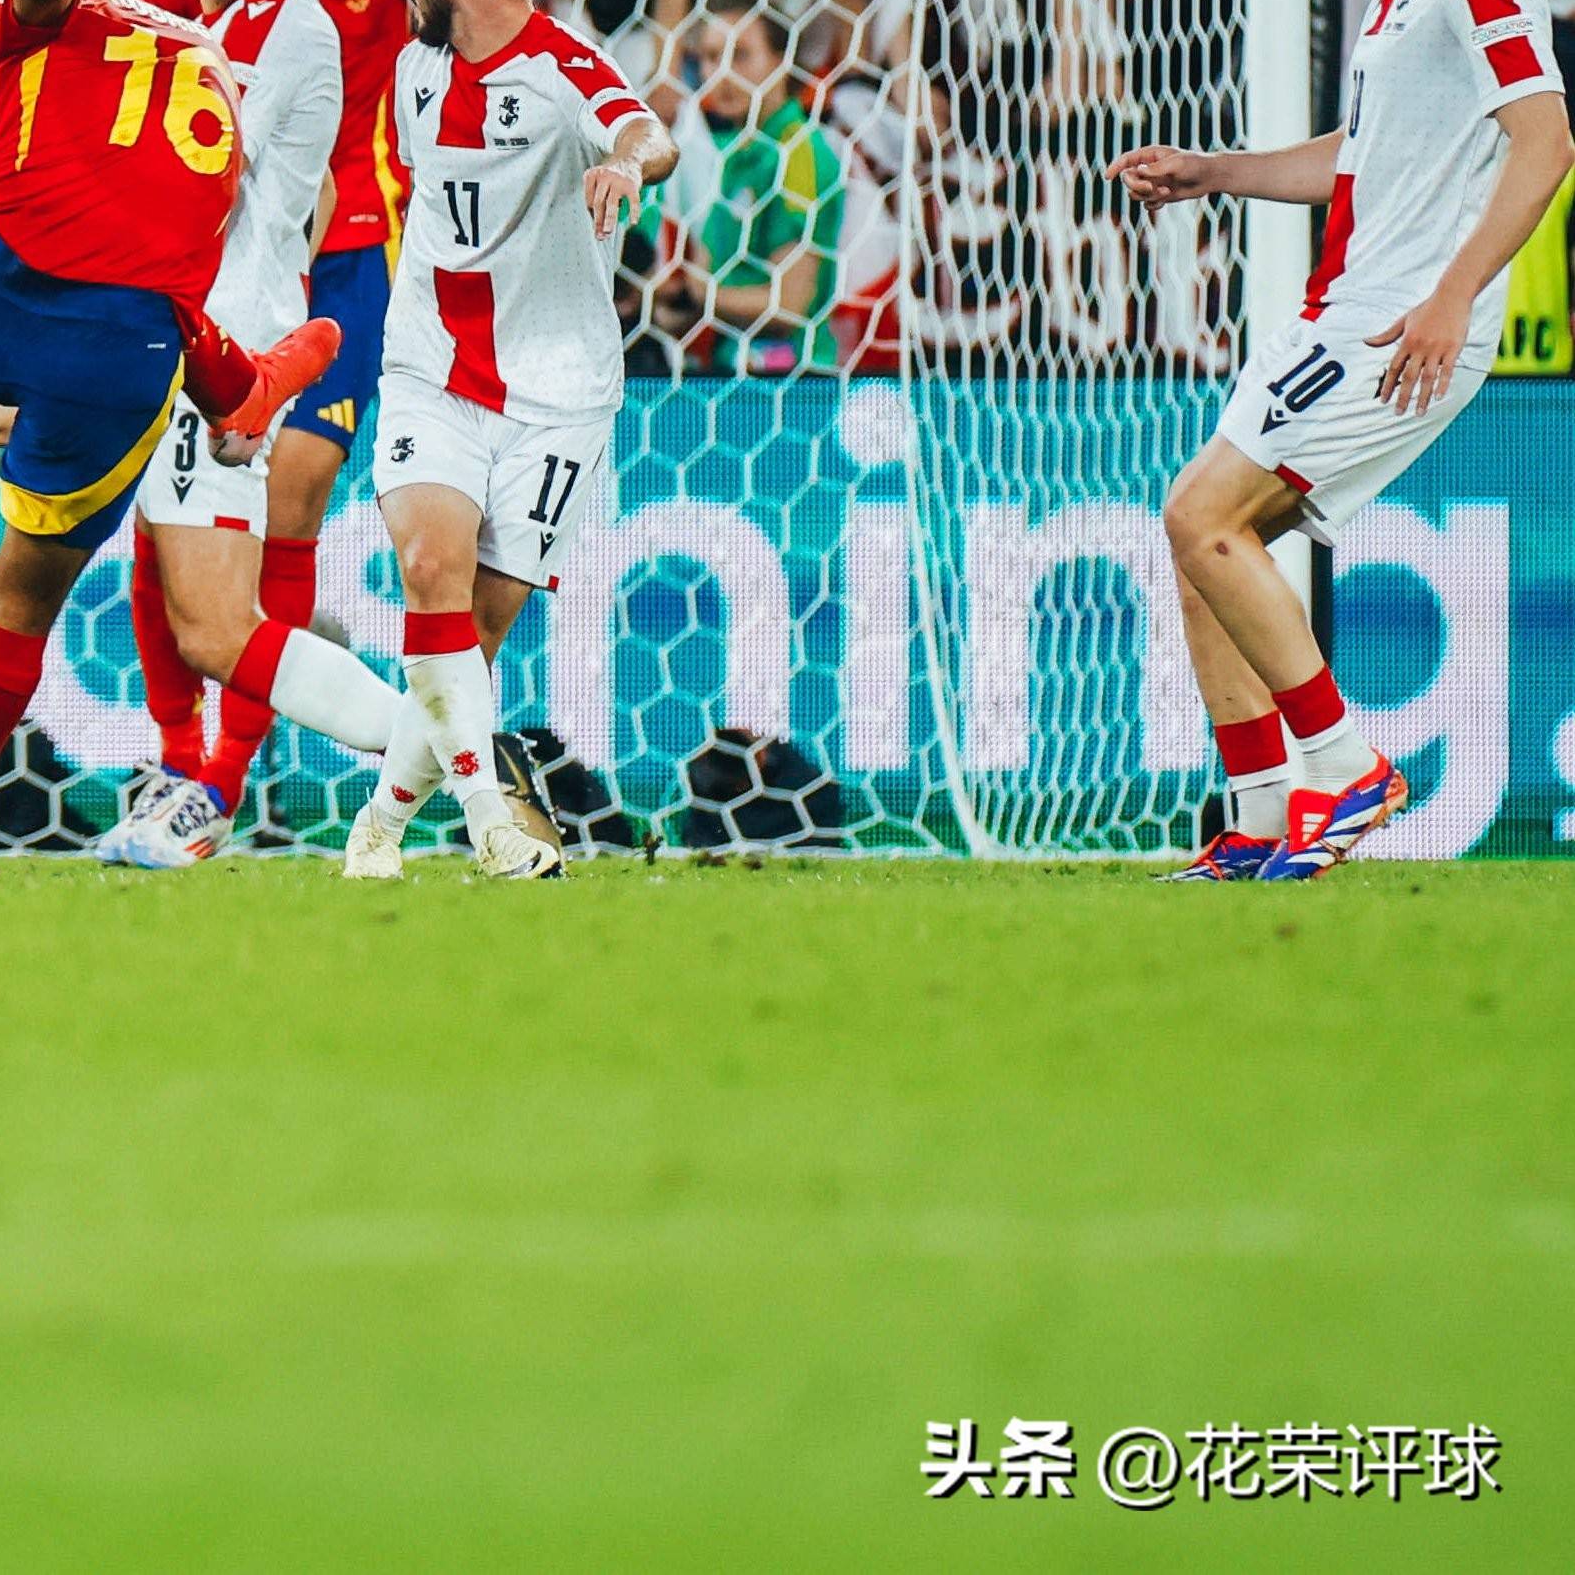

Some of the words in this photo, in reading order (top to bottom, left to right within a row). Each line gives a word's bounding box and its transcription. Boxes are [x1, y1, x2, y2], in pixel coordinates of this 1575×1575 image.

[103, 26, 234, 175] 16
[1266, 342, 1345, 413] 10
[175, 411, 199, 472] 3
